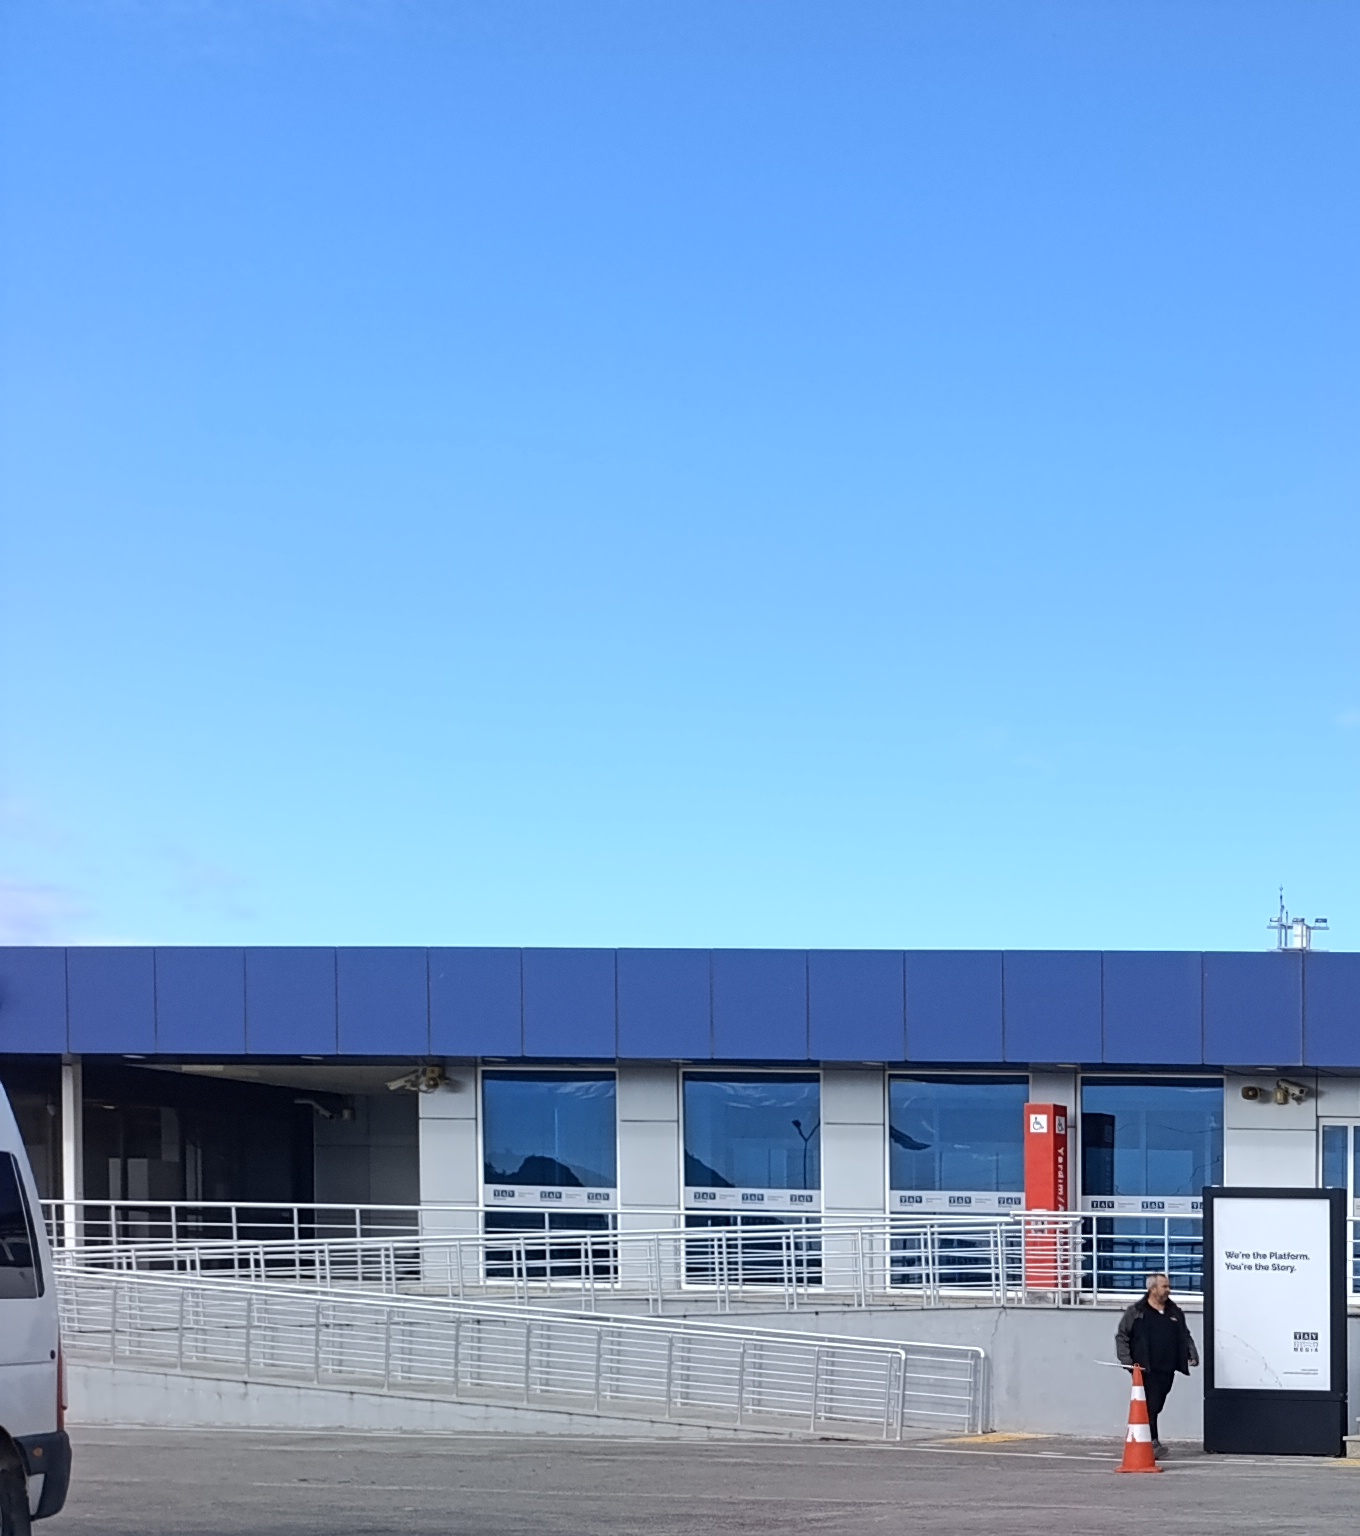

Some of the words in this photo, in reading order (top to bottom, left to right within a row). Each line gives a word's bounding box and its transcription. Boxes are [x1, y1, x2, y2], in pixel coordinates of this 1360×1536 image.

[1225, 1251, 1251, 1260] We're
[1252, 1251, 1267, 1259] the
[1269, 1251, 1310, 1260] Platform.
[1225, 1262, 1253, 1271] You're
[1255, 1262, 1270, 1271] the
[1271, 1263, 1297, 1273] Story.
